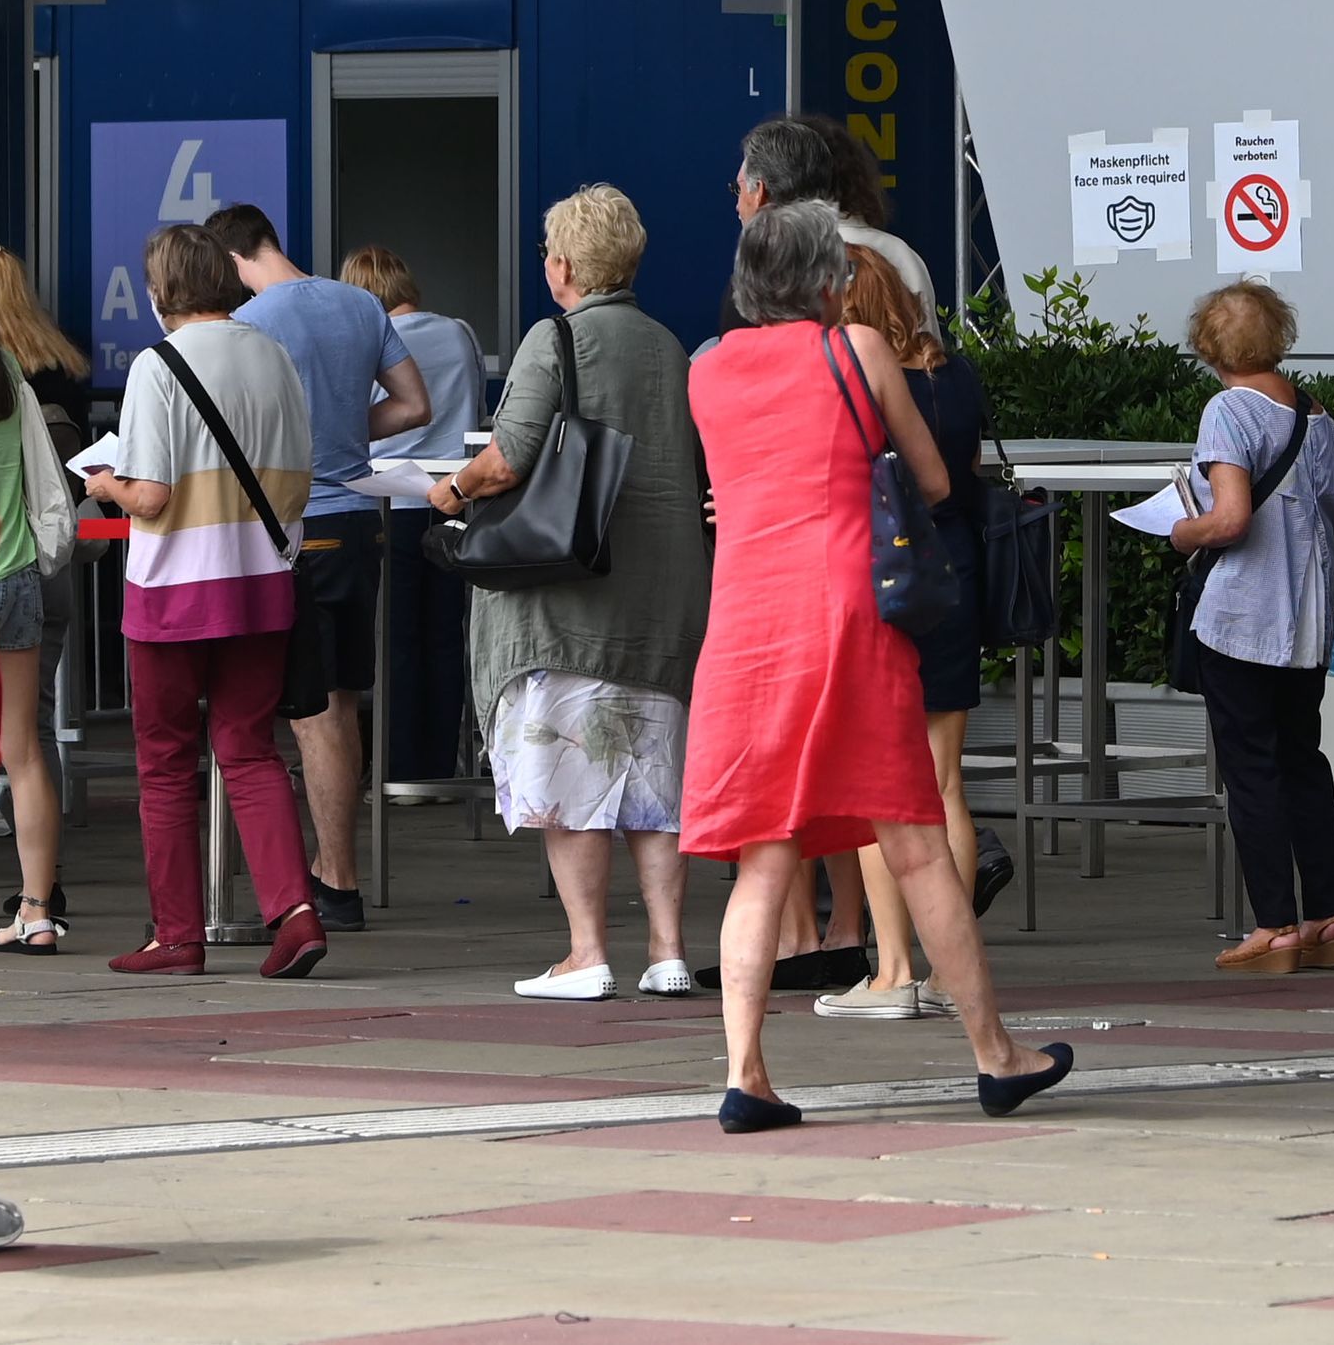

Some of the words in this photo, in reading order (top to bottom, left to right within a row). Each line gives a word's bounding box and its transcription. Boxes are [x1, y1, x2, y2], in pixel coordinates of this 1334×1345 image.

[1235, 135, 1275, 147] Rauchen
[1089, 153, 1170, 170] Maskenpflicht
[1232, 150, 1278, 162] verboten!
[158, 139, 221, 226] 4
[1074, 175, 1099, 187] face
[1102, 173, 1133, 186] mask
[1136, 170, 1186, 187] required
[100, 266, 139, 321] A
